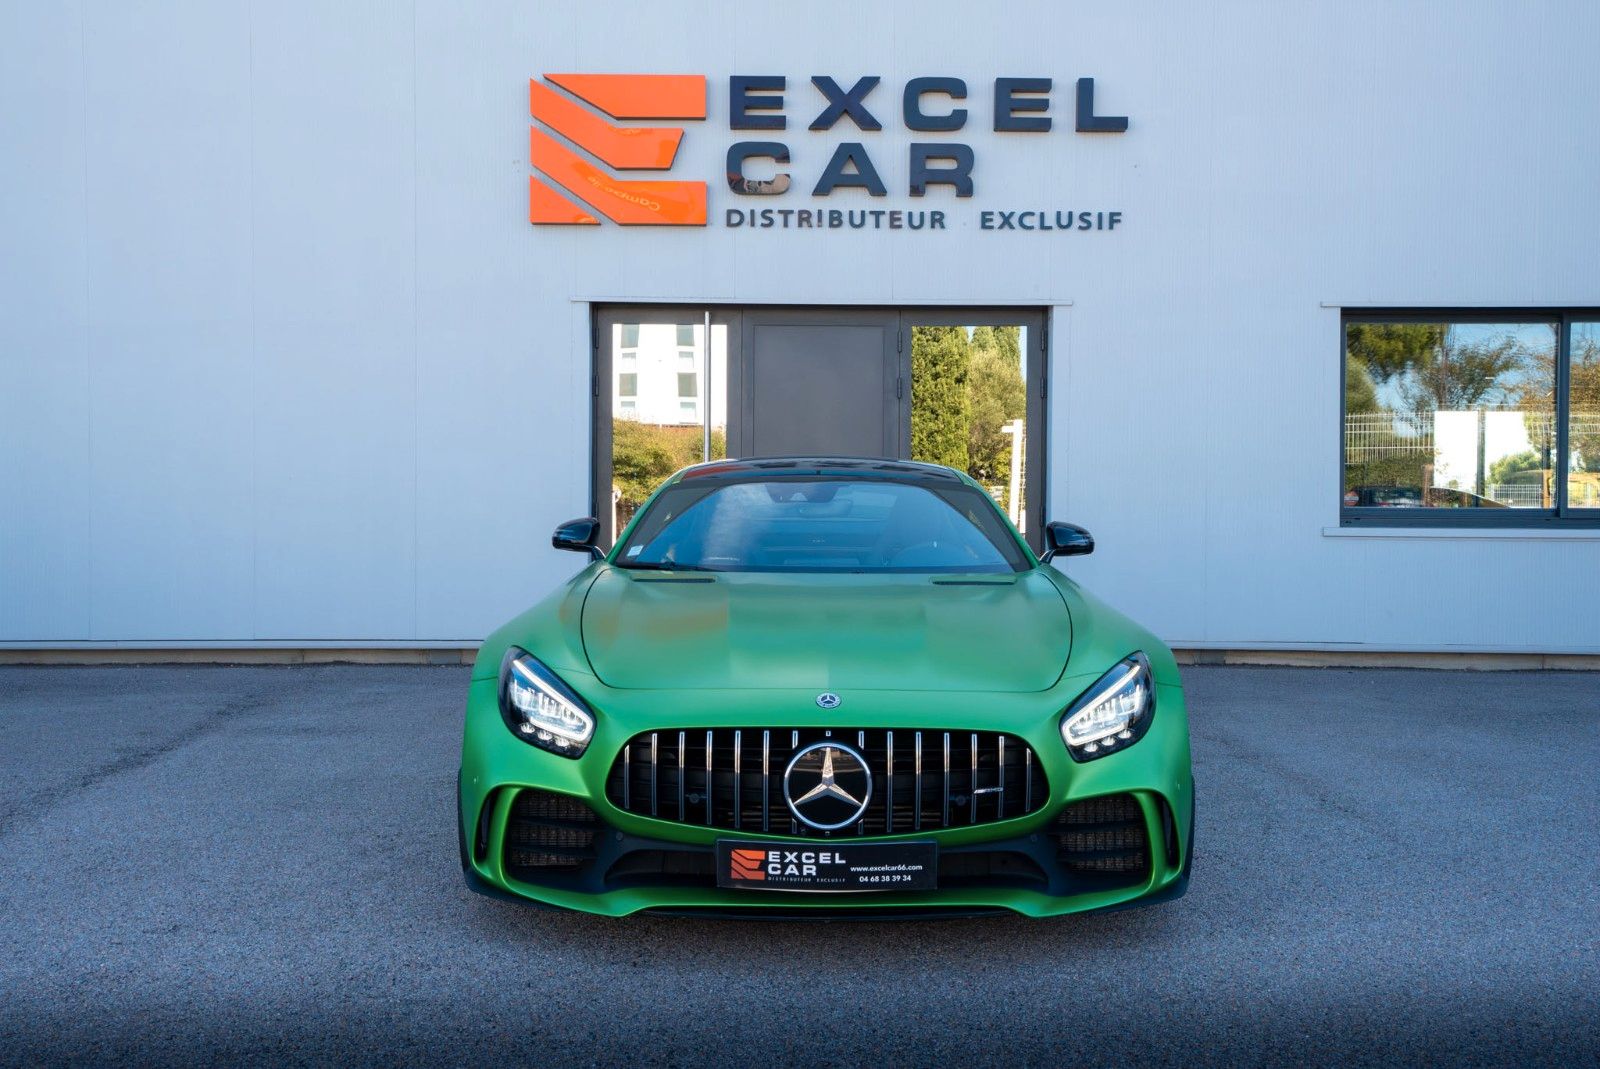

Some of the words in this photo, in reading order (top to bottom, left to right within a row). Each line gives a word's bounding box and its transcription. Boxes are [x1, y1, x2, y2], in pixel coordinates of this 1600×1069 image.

[729, 75, 1129, 133] EXCEL
[726, 141, 974, 198] CAR
[726, 209, 946, 230] DISTRIBUTEUR
[981, 211, 1123, 231] EXCLUSIF
[768, 851, 846, 864] EXCEL
[767, 863, 817, 876] CAR
[850, 864, 923, 872] www.excelcar66.com
[859, 875, 869, 883] 04
[892, 874, 901, 882] 39
